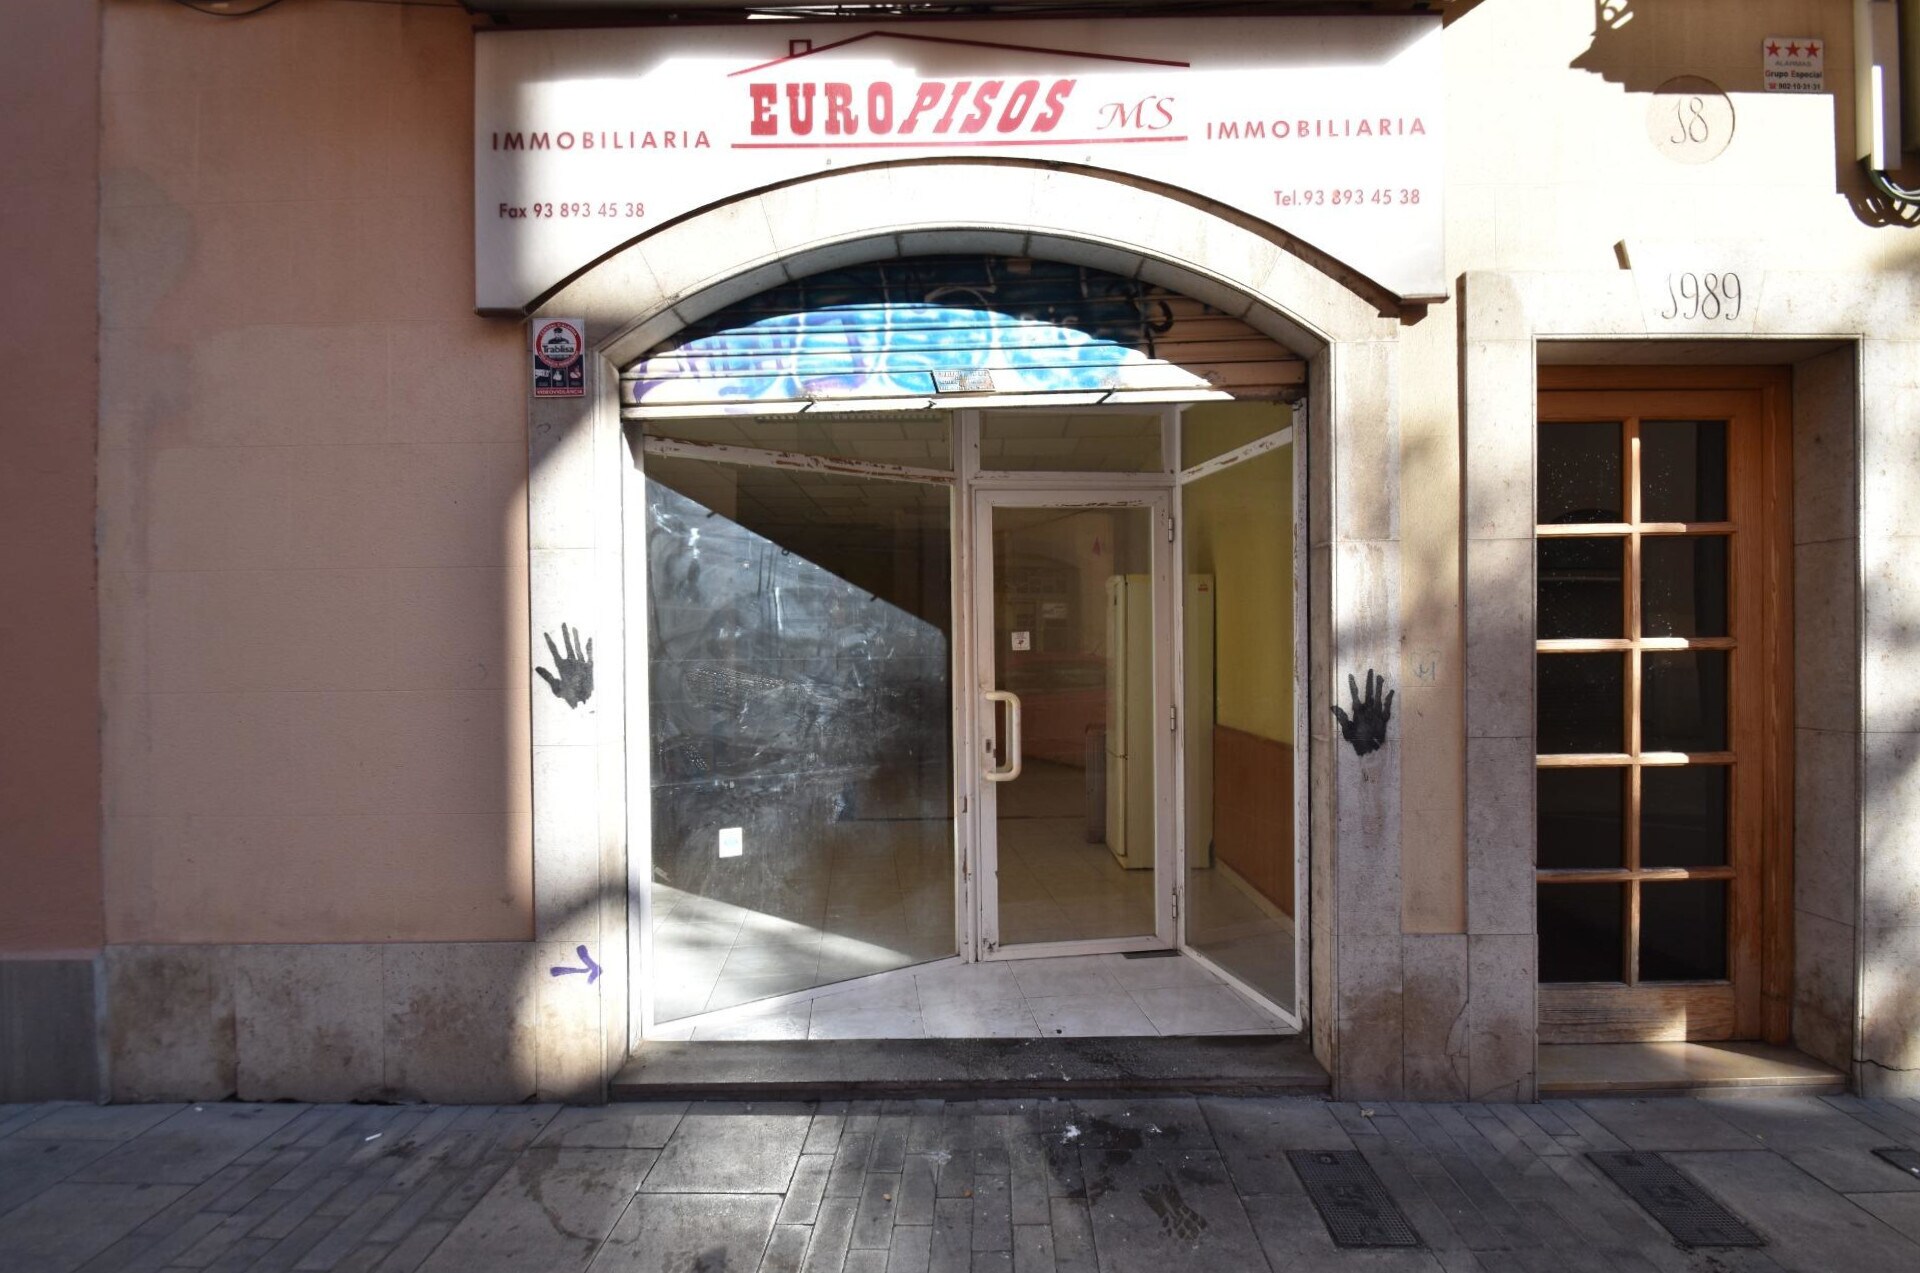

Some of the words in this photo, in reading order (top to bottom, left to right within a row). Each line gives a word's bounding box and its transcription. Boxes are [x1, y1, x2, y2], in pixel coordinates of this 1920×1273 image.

[1765, 69, 1789, 79] Grupo
[1791, 69, 1822, 80] Especial
[750, 79, 1076, 136] EUROPISOS
[1098, 96, 1175, 131] MS
[1207, 117, 1426, 140] IMMOBILIARIA
[493, 131, 711, 151] IMMOBILIARIA
[1332, 189, 1364, 206] 893
[1371, 189, 1393, 206] 45
[1400, 189, 1421, 206] 38
[499, 203, 527, 218] Fax
[534, 203, 553, 218] 93
[560, 203, 591, 218] 893
[598, 203, 618, 218] 45
[625, 203, 645, 218] 38
[542, 344, 574, 353] Trablisa
